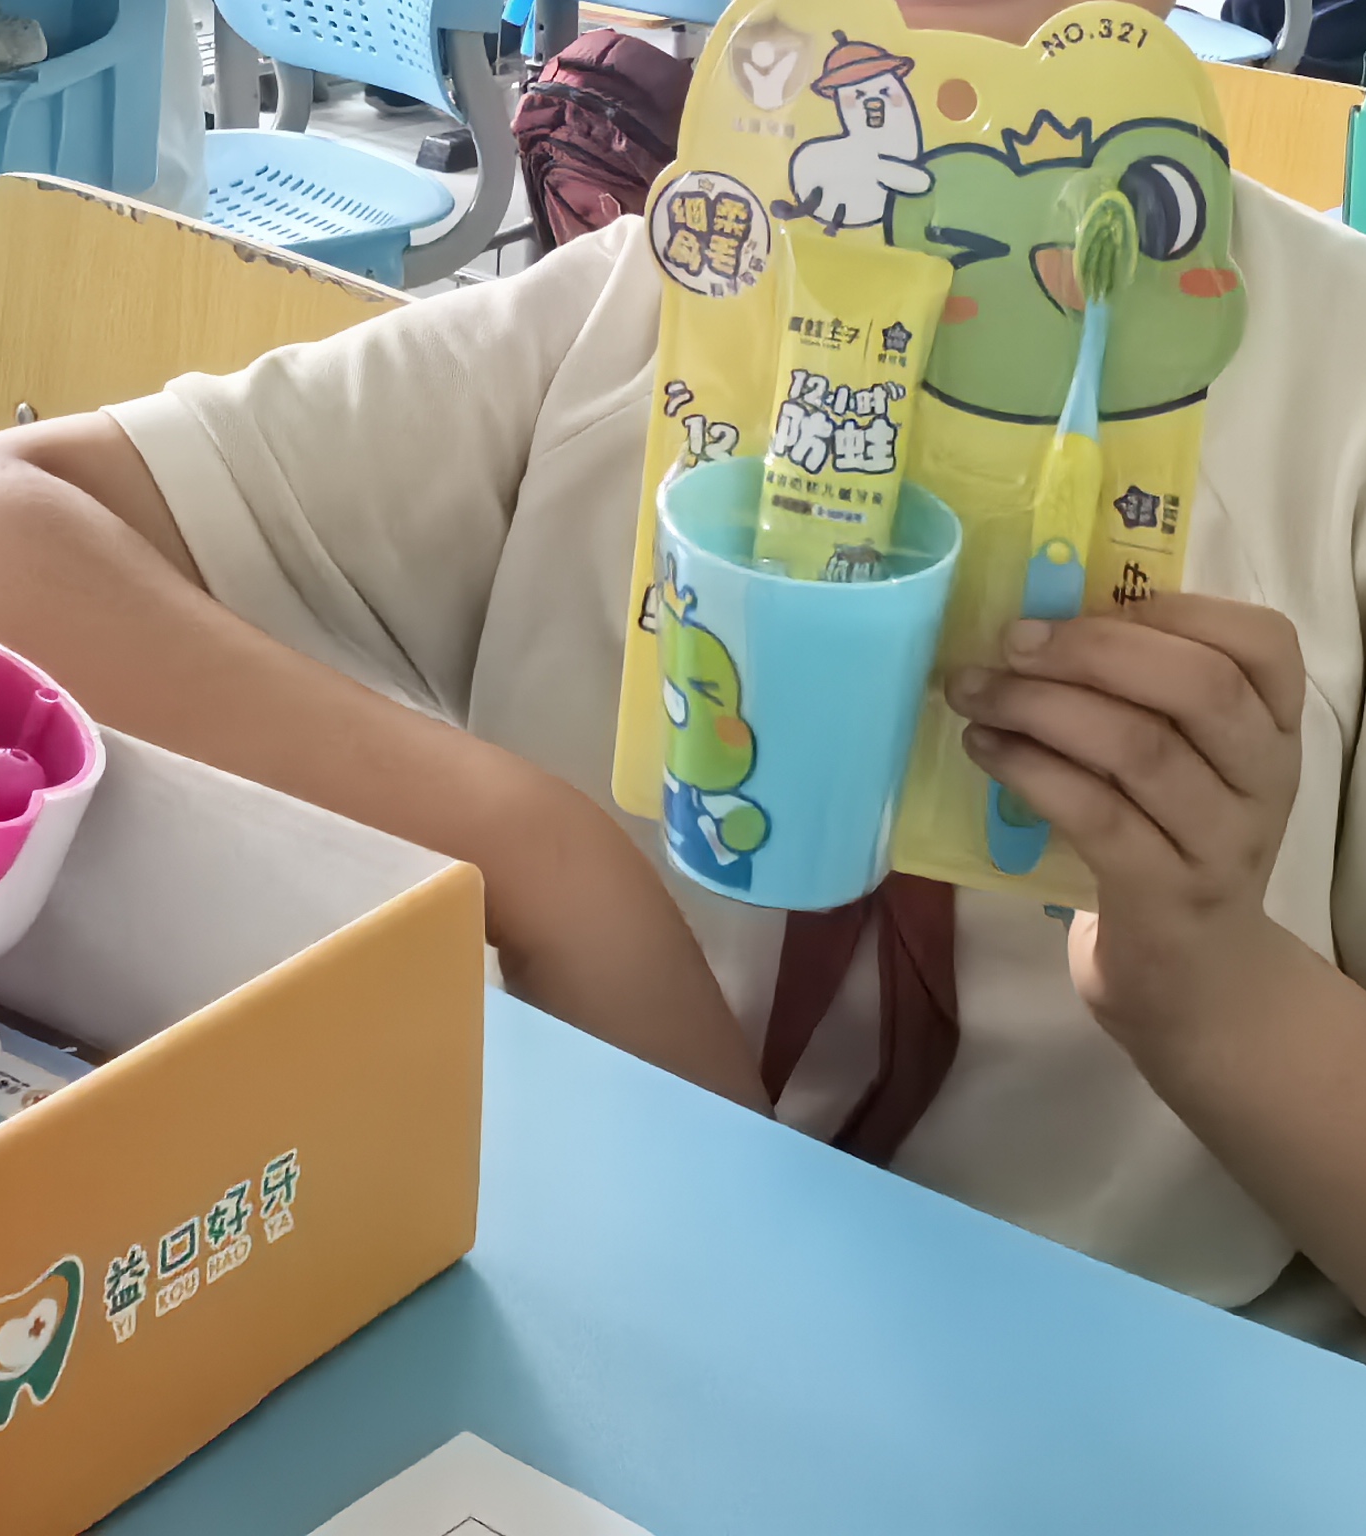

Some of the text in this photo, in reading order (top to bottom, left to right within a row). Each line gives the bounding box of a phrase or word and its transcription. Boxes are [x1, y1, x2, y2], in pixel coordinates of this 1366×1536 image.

[1041, 18, 1148, 57] NO.321
[104, 1149, 300, 1320] 益口好牙
